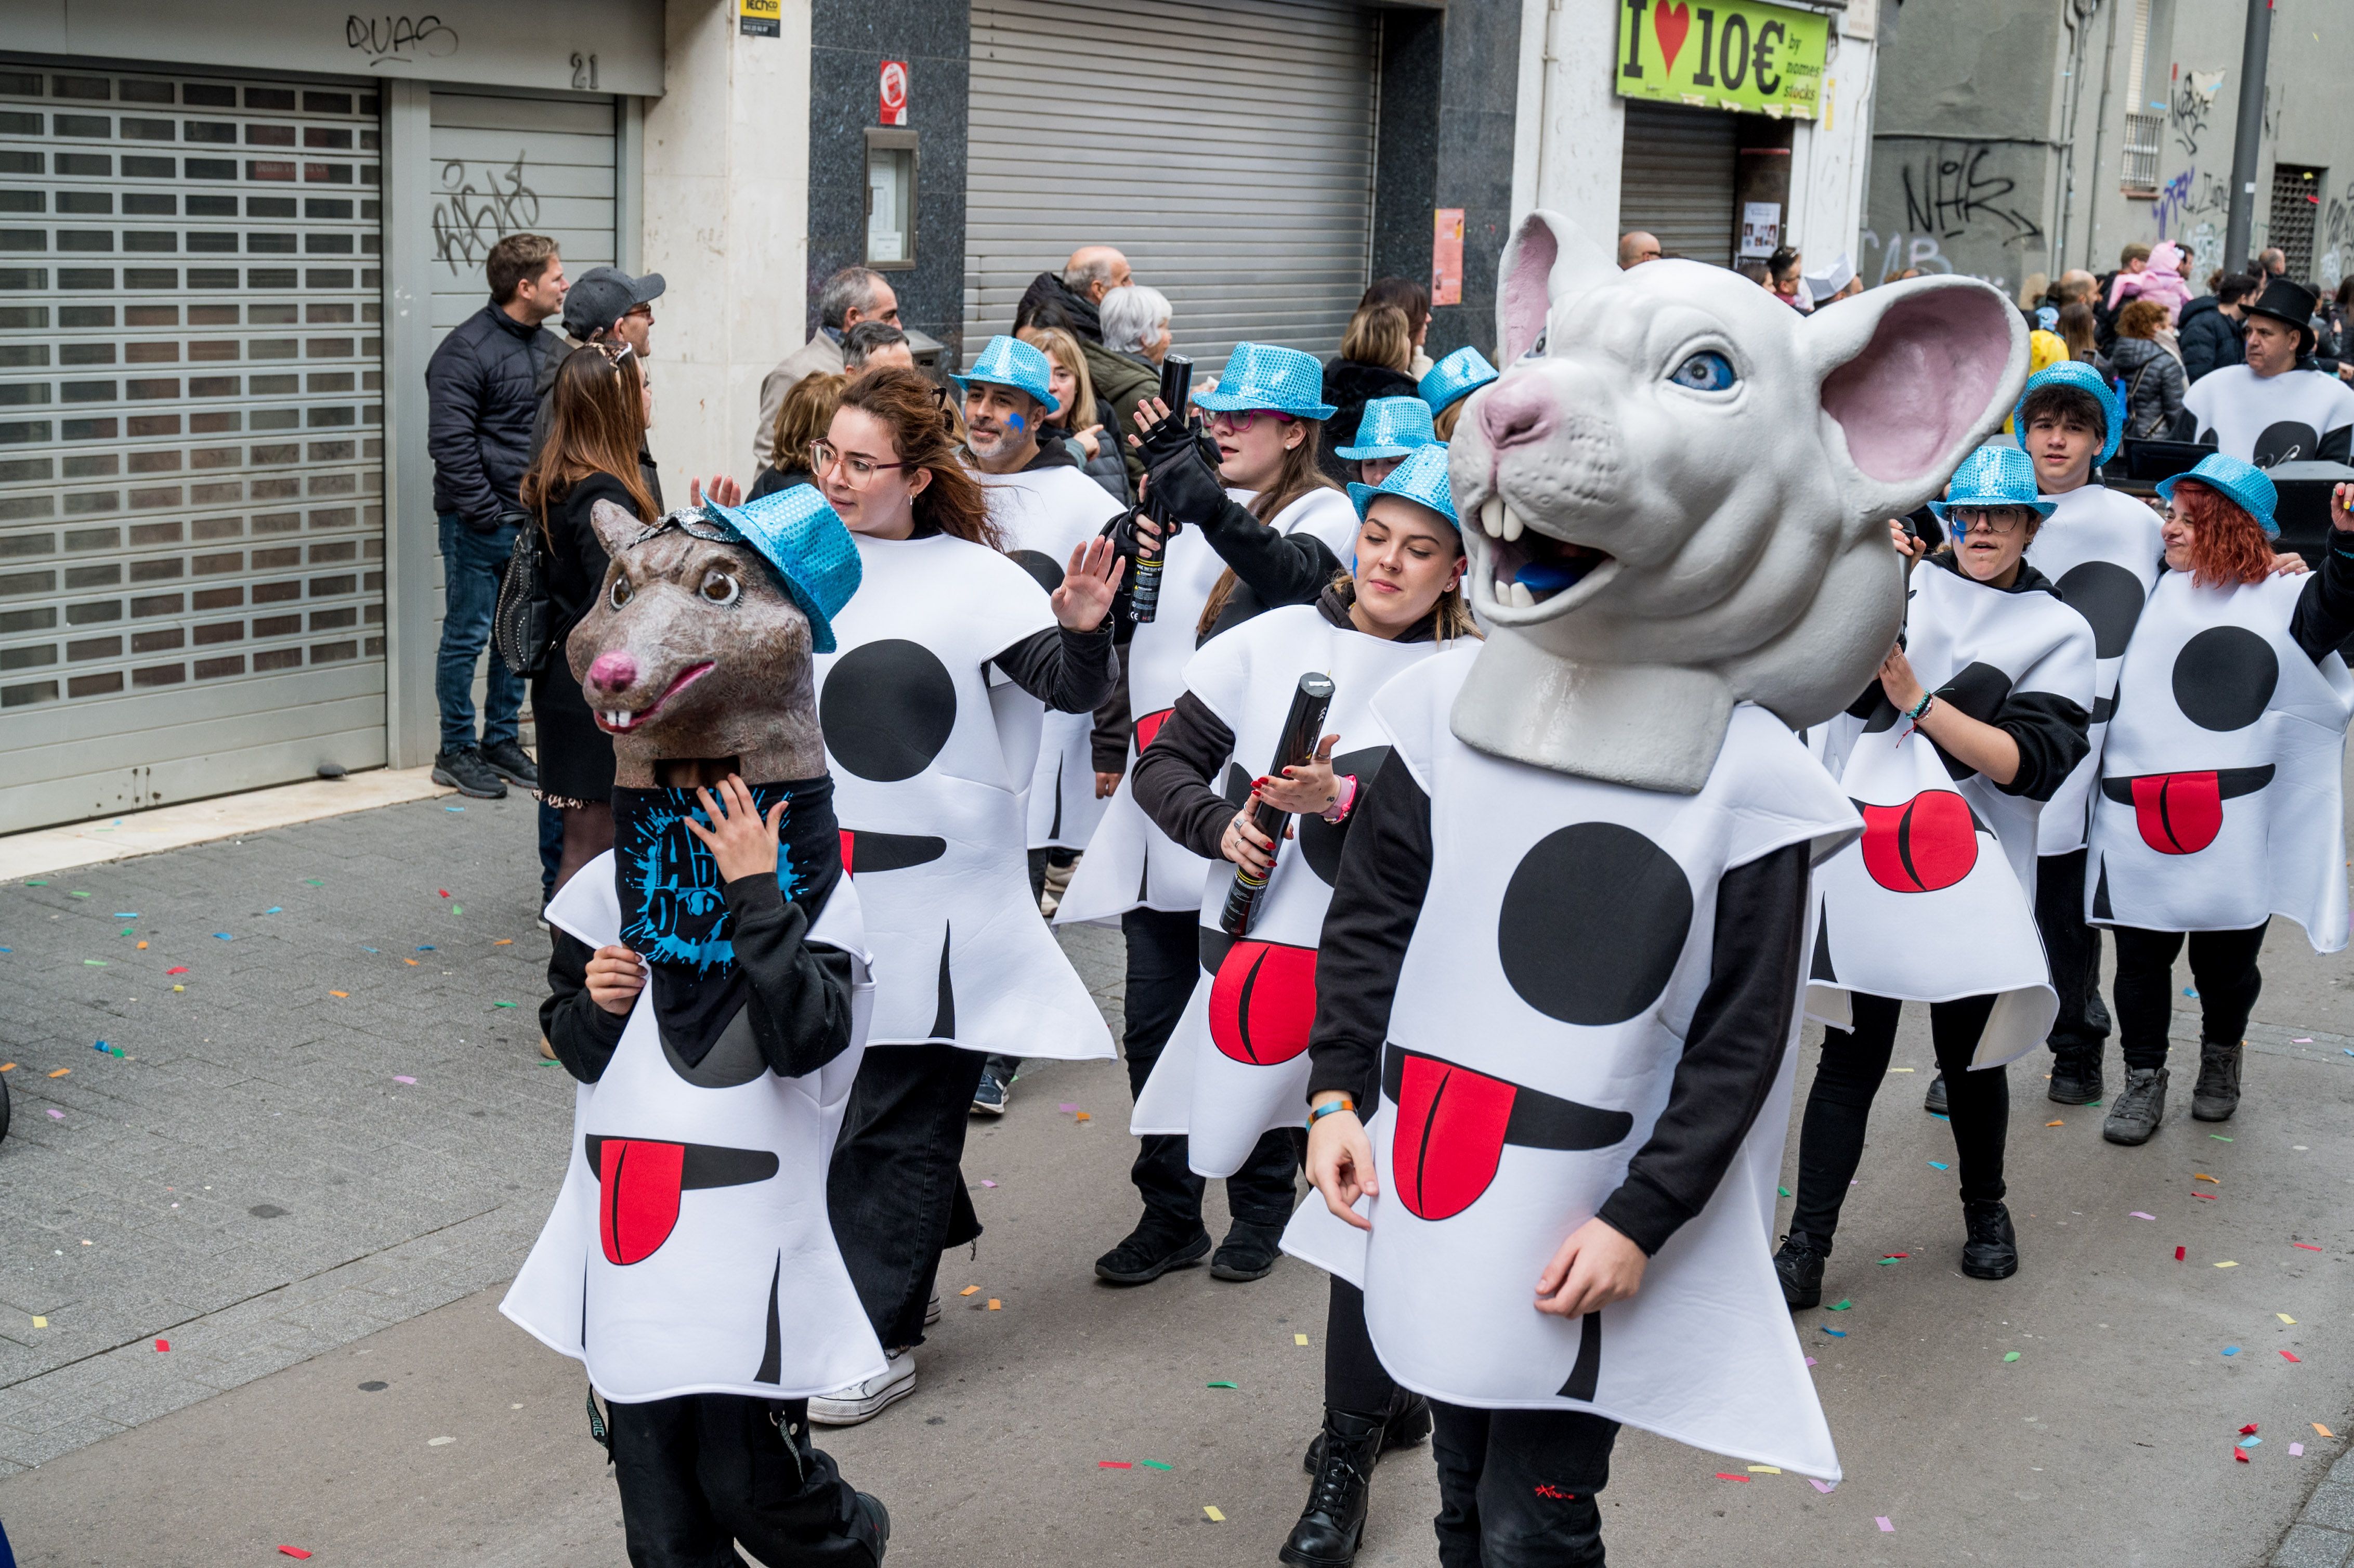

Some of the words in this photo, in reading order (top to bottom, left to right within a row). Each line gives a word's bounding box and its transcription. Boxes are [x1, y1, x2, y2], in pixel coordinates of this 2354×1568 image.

[1693, 8, 1786, 95] 10€
[1788, 33, 1802, 55] by
[570, 53, 598, 89] 21
[1784, 84, 1815, 100] stocks
[1130, 611, 1139, 620] CE
